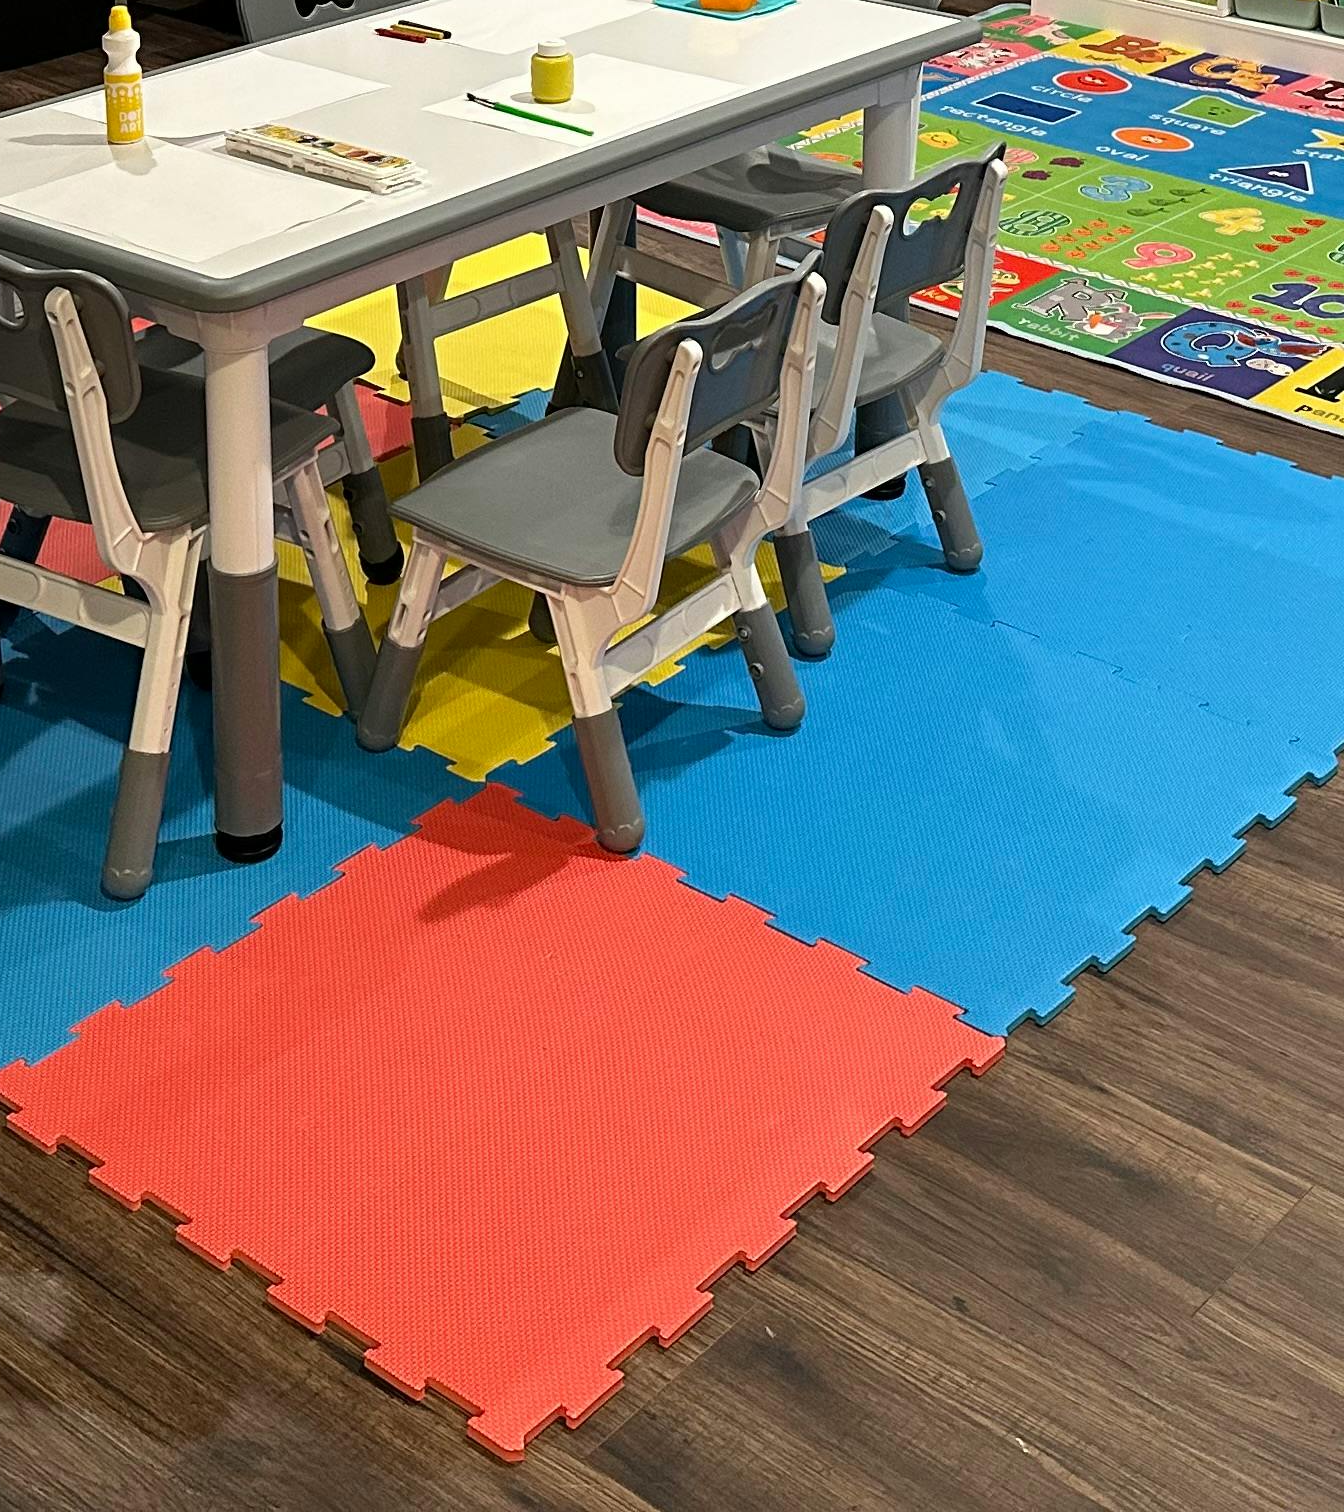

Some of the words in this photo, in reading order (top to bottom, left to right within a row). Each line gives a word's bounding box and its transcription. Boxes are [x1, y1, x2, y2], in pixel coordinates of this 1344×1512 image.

[1031, 85, 1094, 103] circle
[119, 108, 142, 122] DOT
[119, 120, 142, 134] ART
[939, 104, 1049, 137] rectangle
[1148, 113, 1227, 136] square
[1095, 145, 1150, 162] oval
[1078, 175, 1153, 204] 3
[1208, 172, 1307, 203] triangle
[998, 209, 1072, 237] 8
[1199, 207, 1266, 236] 4
[1122, 242, 1197, 270] 9
[1011, 277, 1128, 323] R
[1018, 318, 1080, 342] rabbit
[1160, 321, 1262, 367] Q
[1161, 362, 1215, 382] quail
